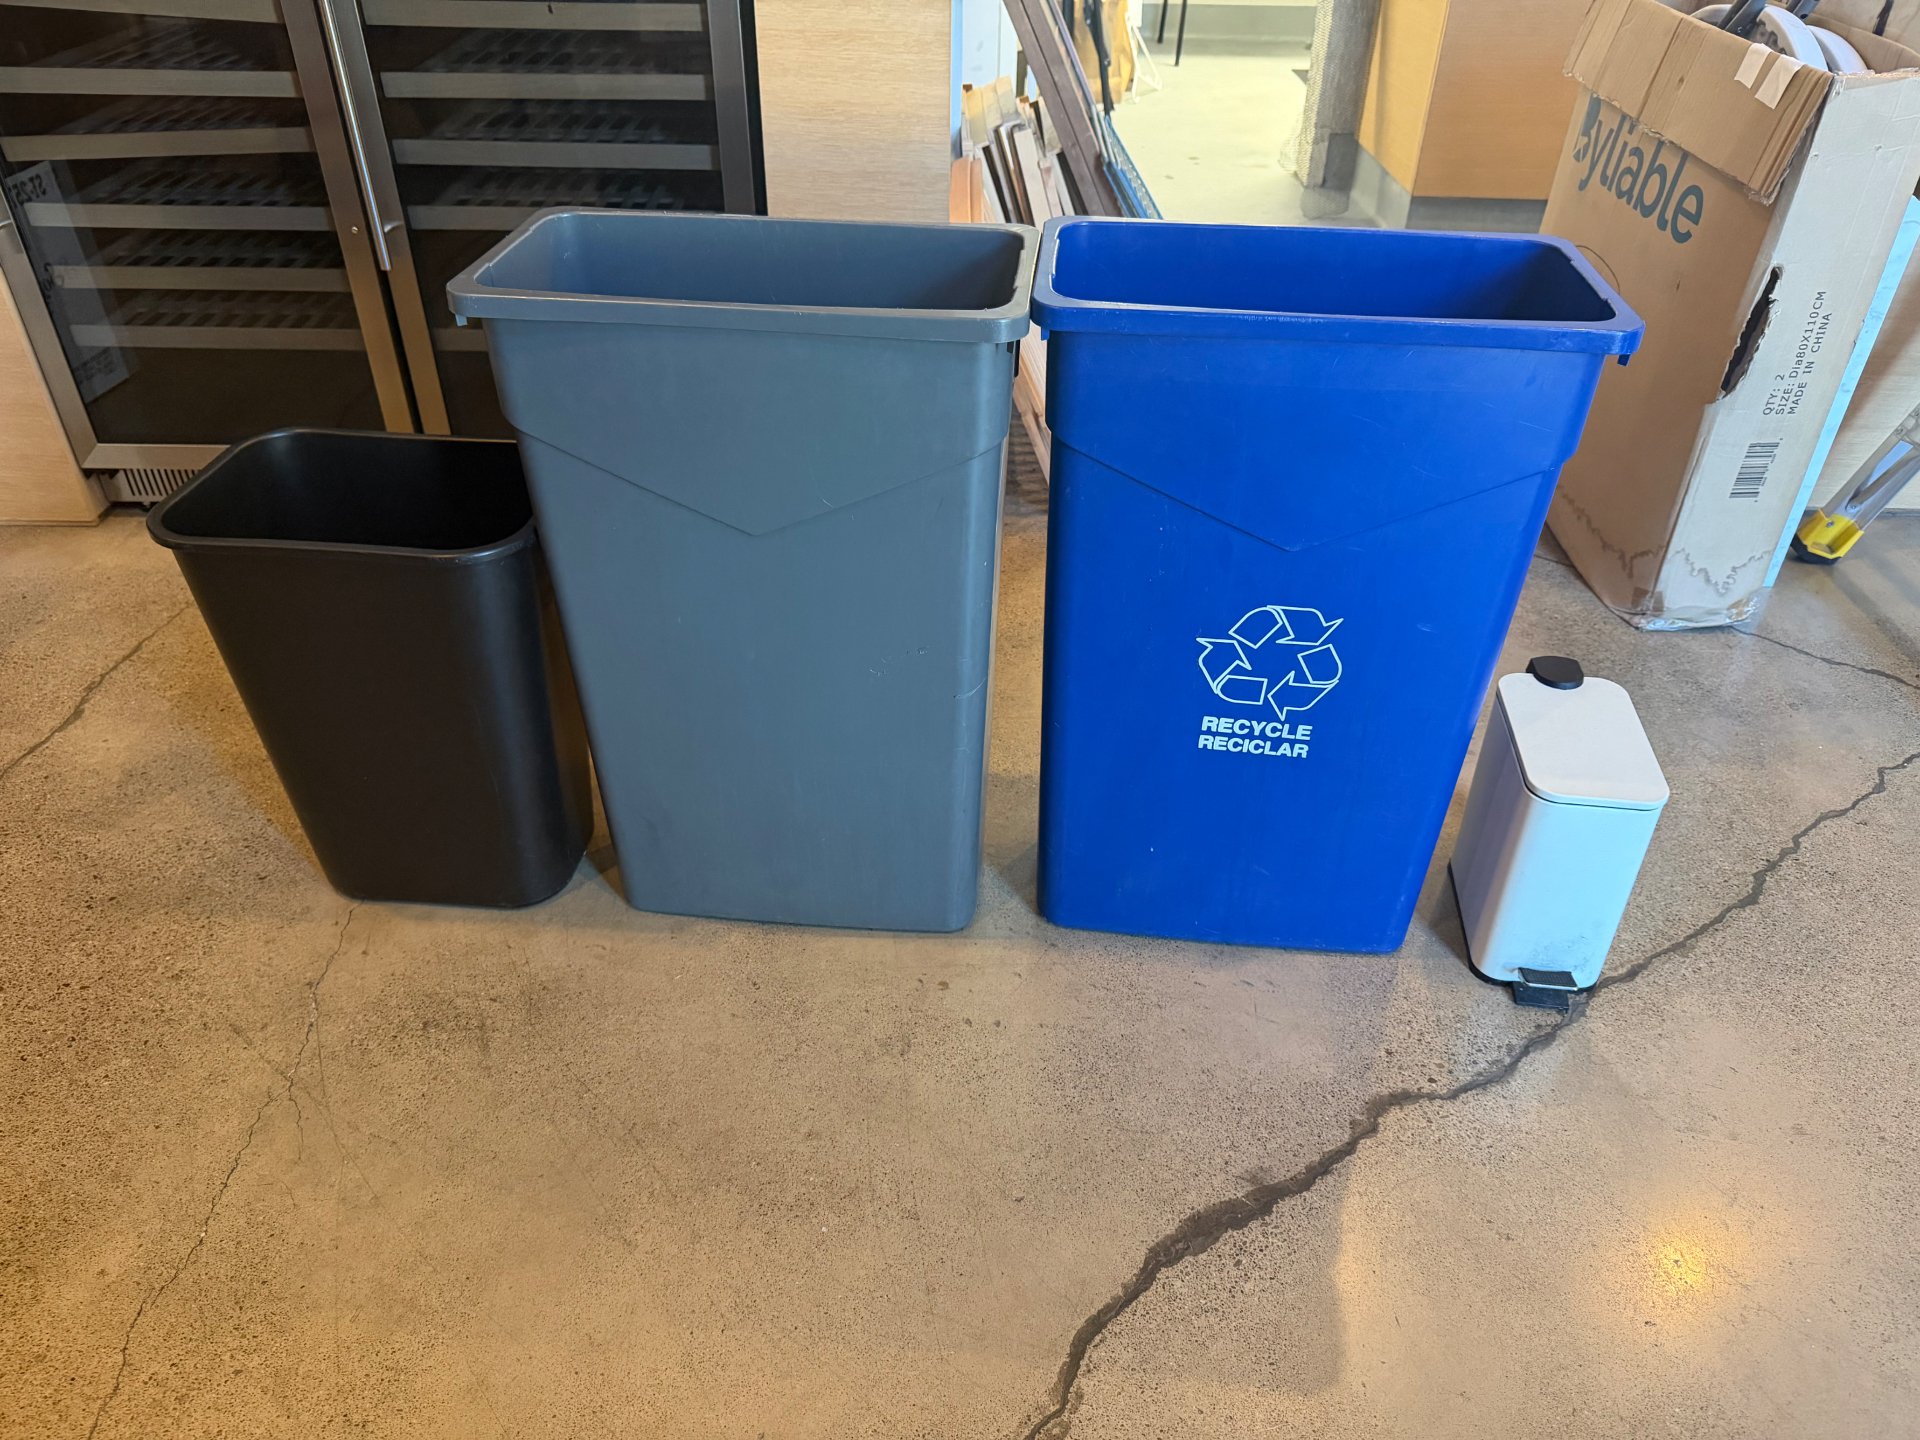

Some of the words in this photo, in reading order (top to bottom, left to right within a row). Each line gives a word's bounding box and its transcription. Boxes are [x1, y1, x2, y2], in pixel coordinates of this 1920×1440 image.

[1787, 382, 1807, 415] MADE
[1803, 361, 1815, 375] IN
[1811, 312, 1832, 353] CHINA
[1763, 388, 1781, 416] QTY:
[1776, 383, 1796, 415] SIZE:
[1201, 716, 1313, 740] RECYCLE
[1198, 735, 1309, 758] RECICLAR
